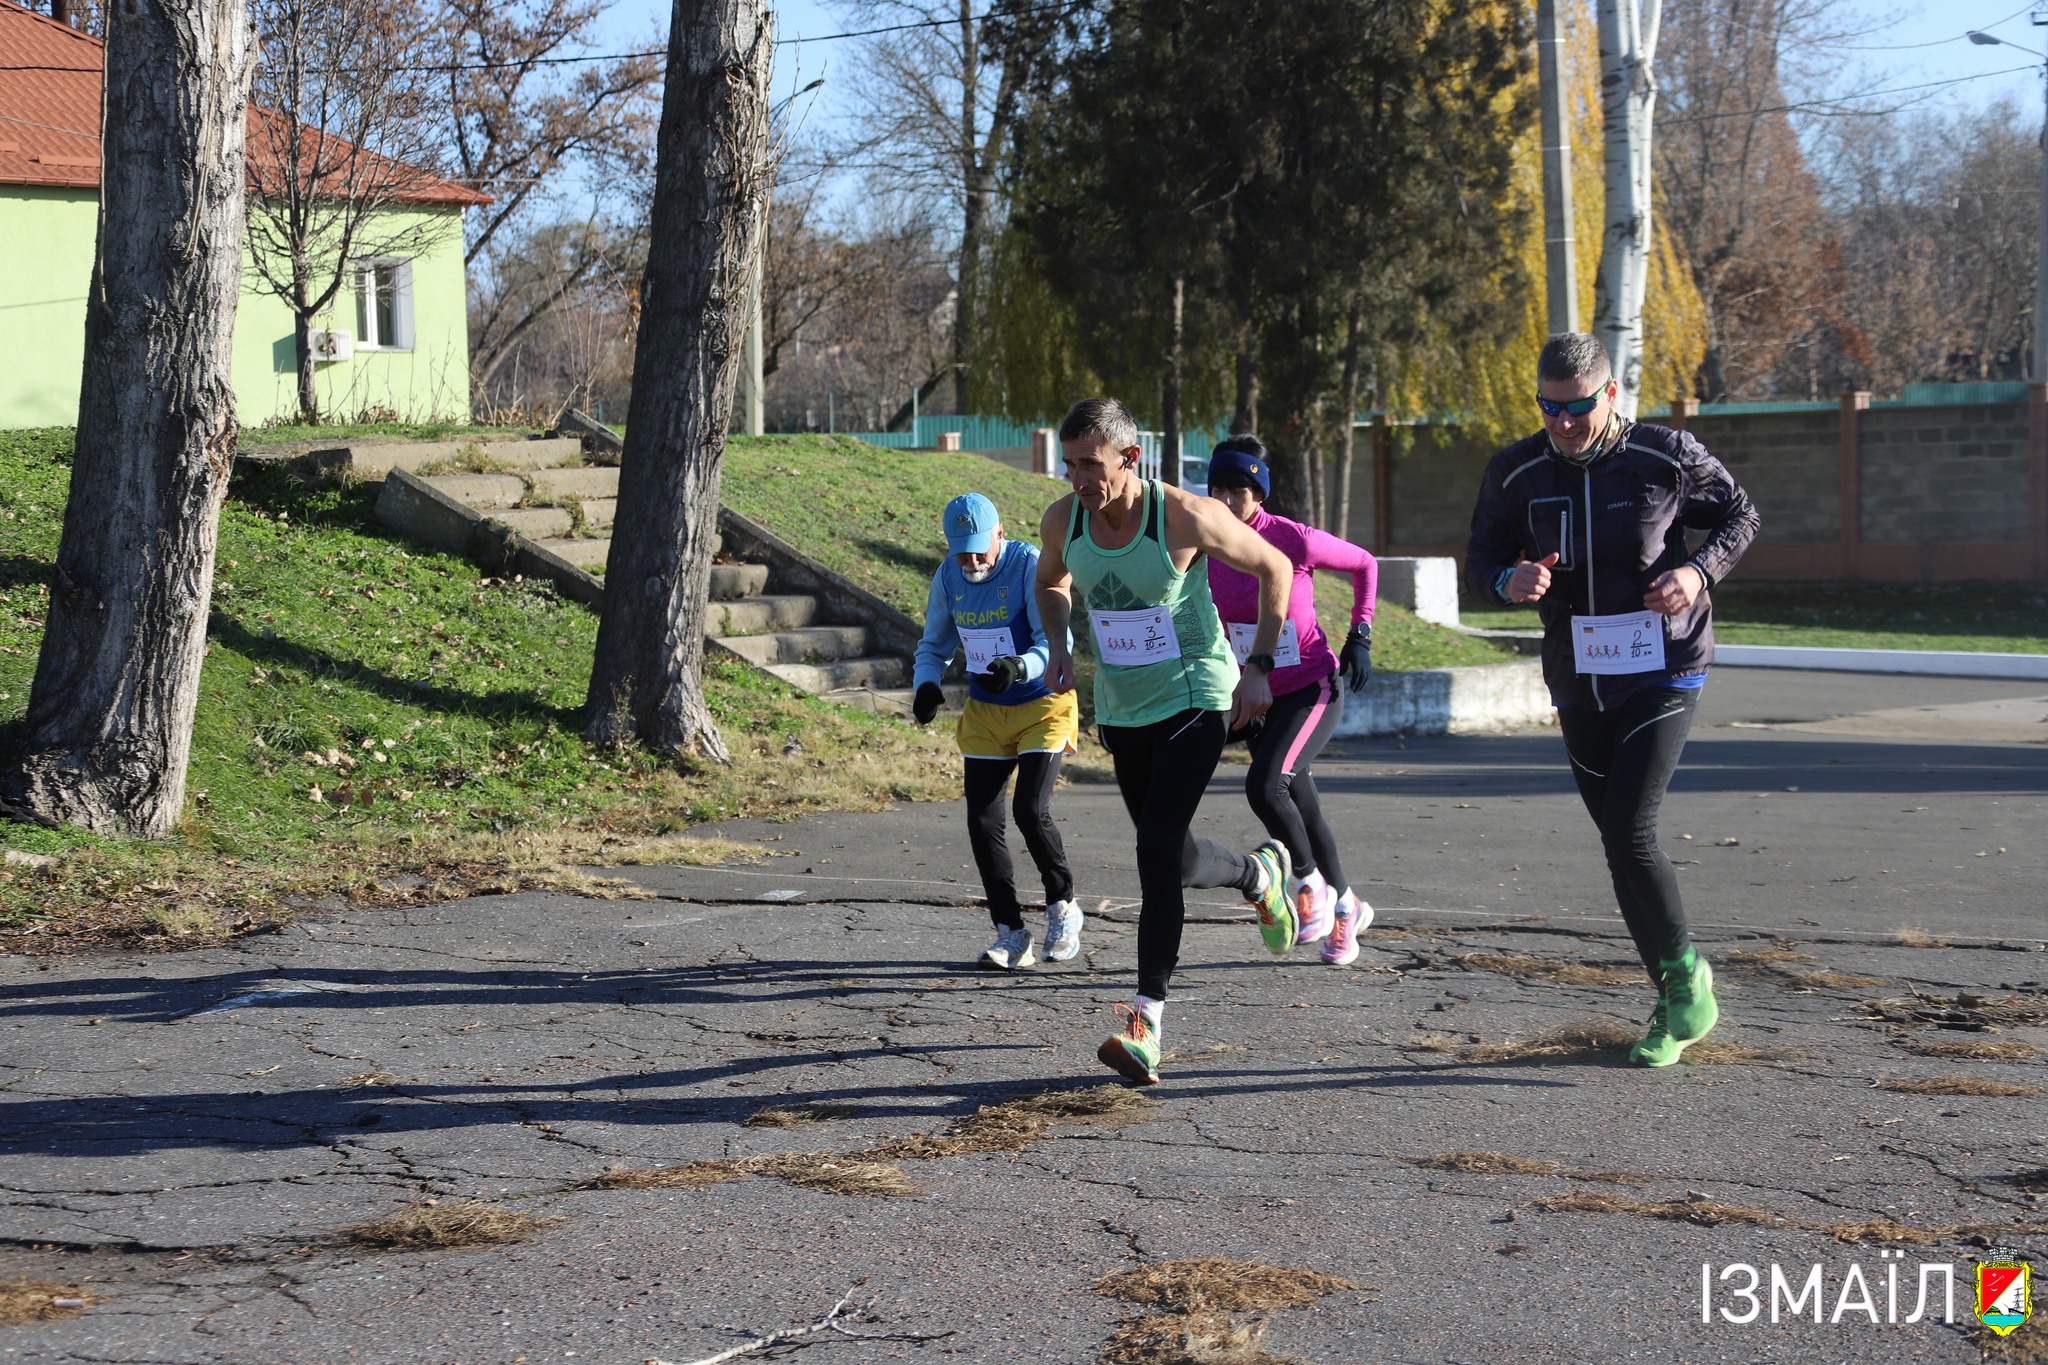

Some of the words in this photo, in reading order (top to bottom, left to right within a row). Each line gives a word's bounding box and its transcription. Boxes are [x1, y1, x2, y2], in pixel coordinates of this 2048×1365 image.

[953, 606, 1009, 626] UKRAINE
[1145, 626, 1156, 638] 3
[1632, 629, 1642, 646] 2
[994, 643, 999, 654] 1
[1145, 640, 1155, 651] 10
[1631, 648, 1641, 658] 10
